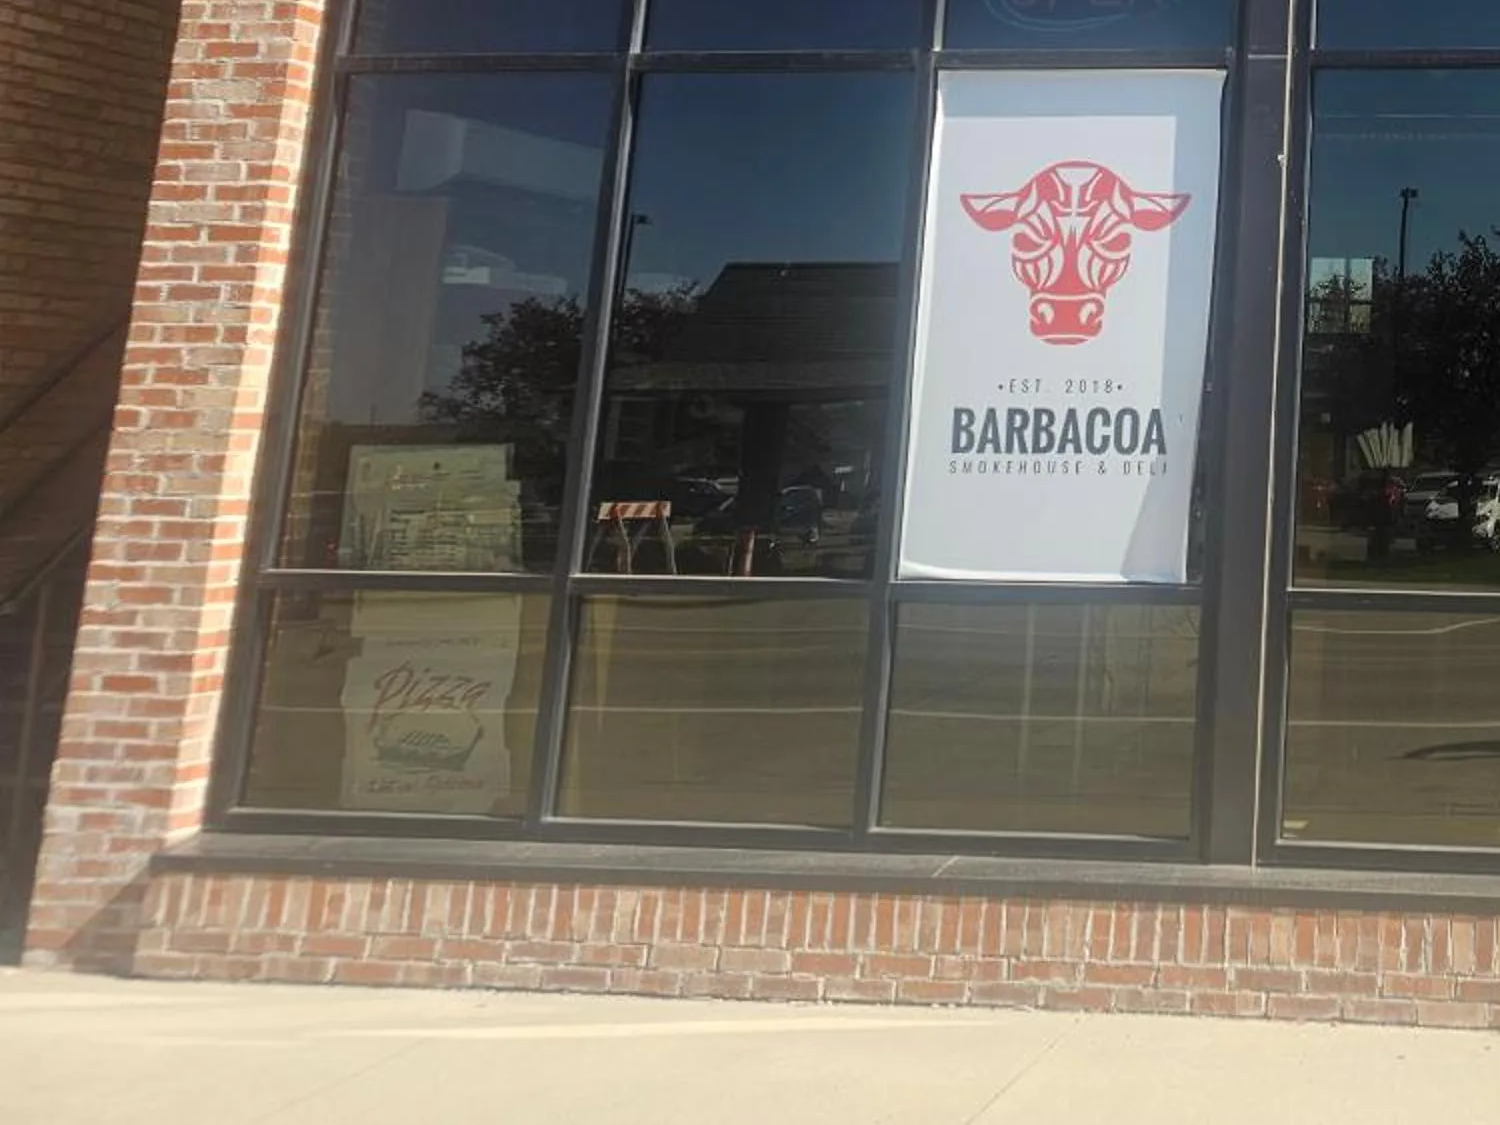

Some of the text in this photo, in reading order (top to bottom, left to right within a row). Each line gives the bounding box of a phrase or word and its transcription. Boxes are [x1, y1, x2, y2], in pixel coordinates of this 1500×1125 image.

[1065, 378, 1113, 394] 2018
[951, 407, 1167, 455] BARBACOA
[949, 459, 1168, 475] SMOKEHOUSE & DELI
[366, 660, 491, 735] Pizza
